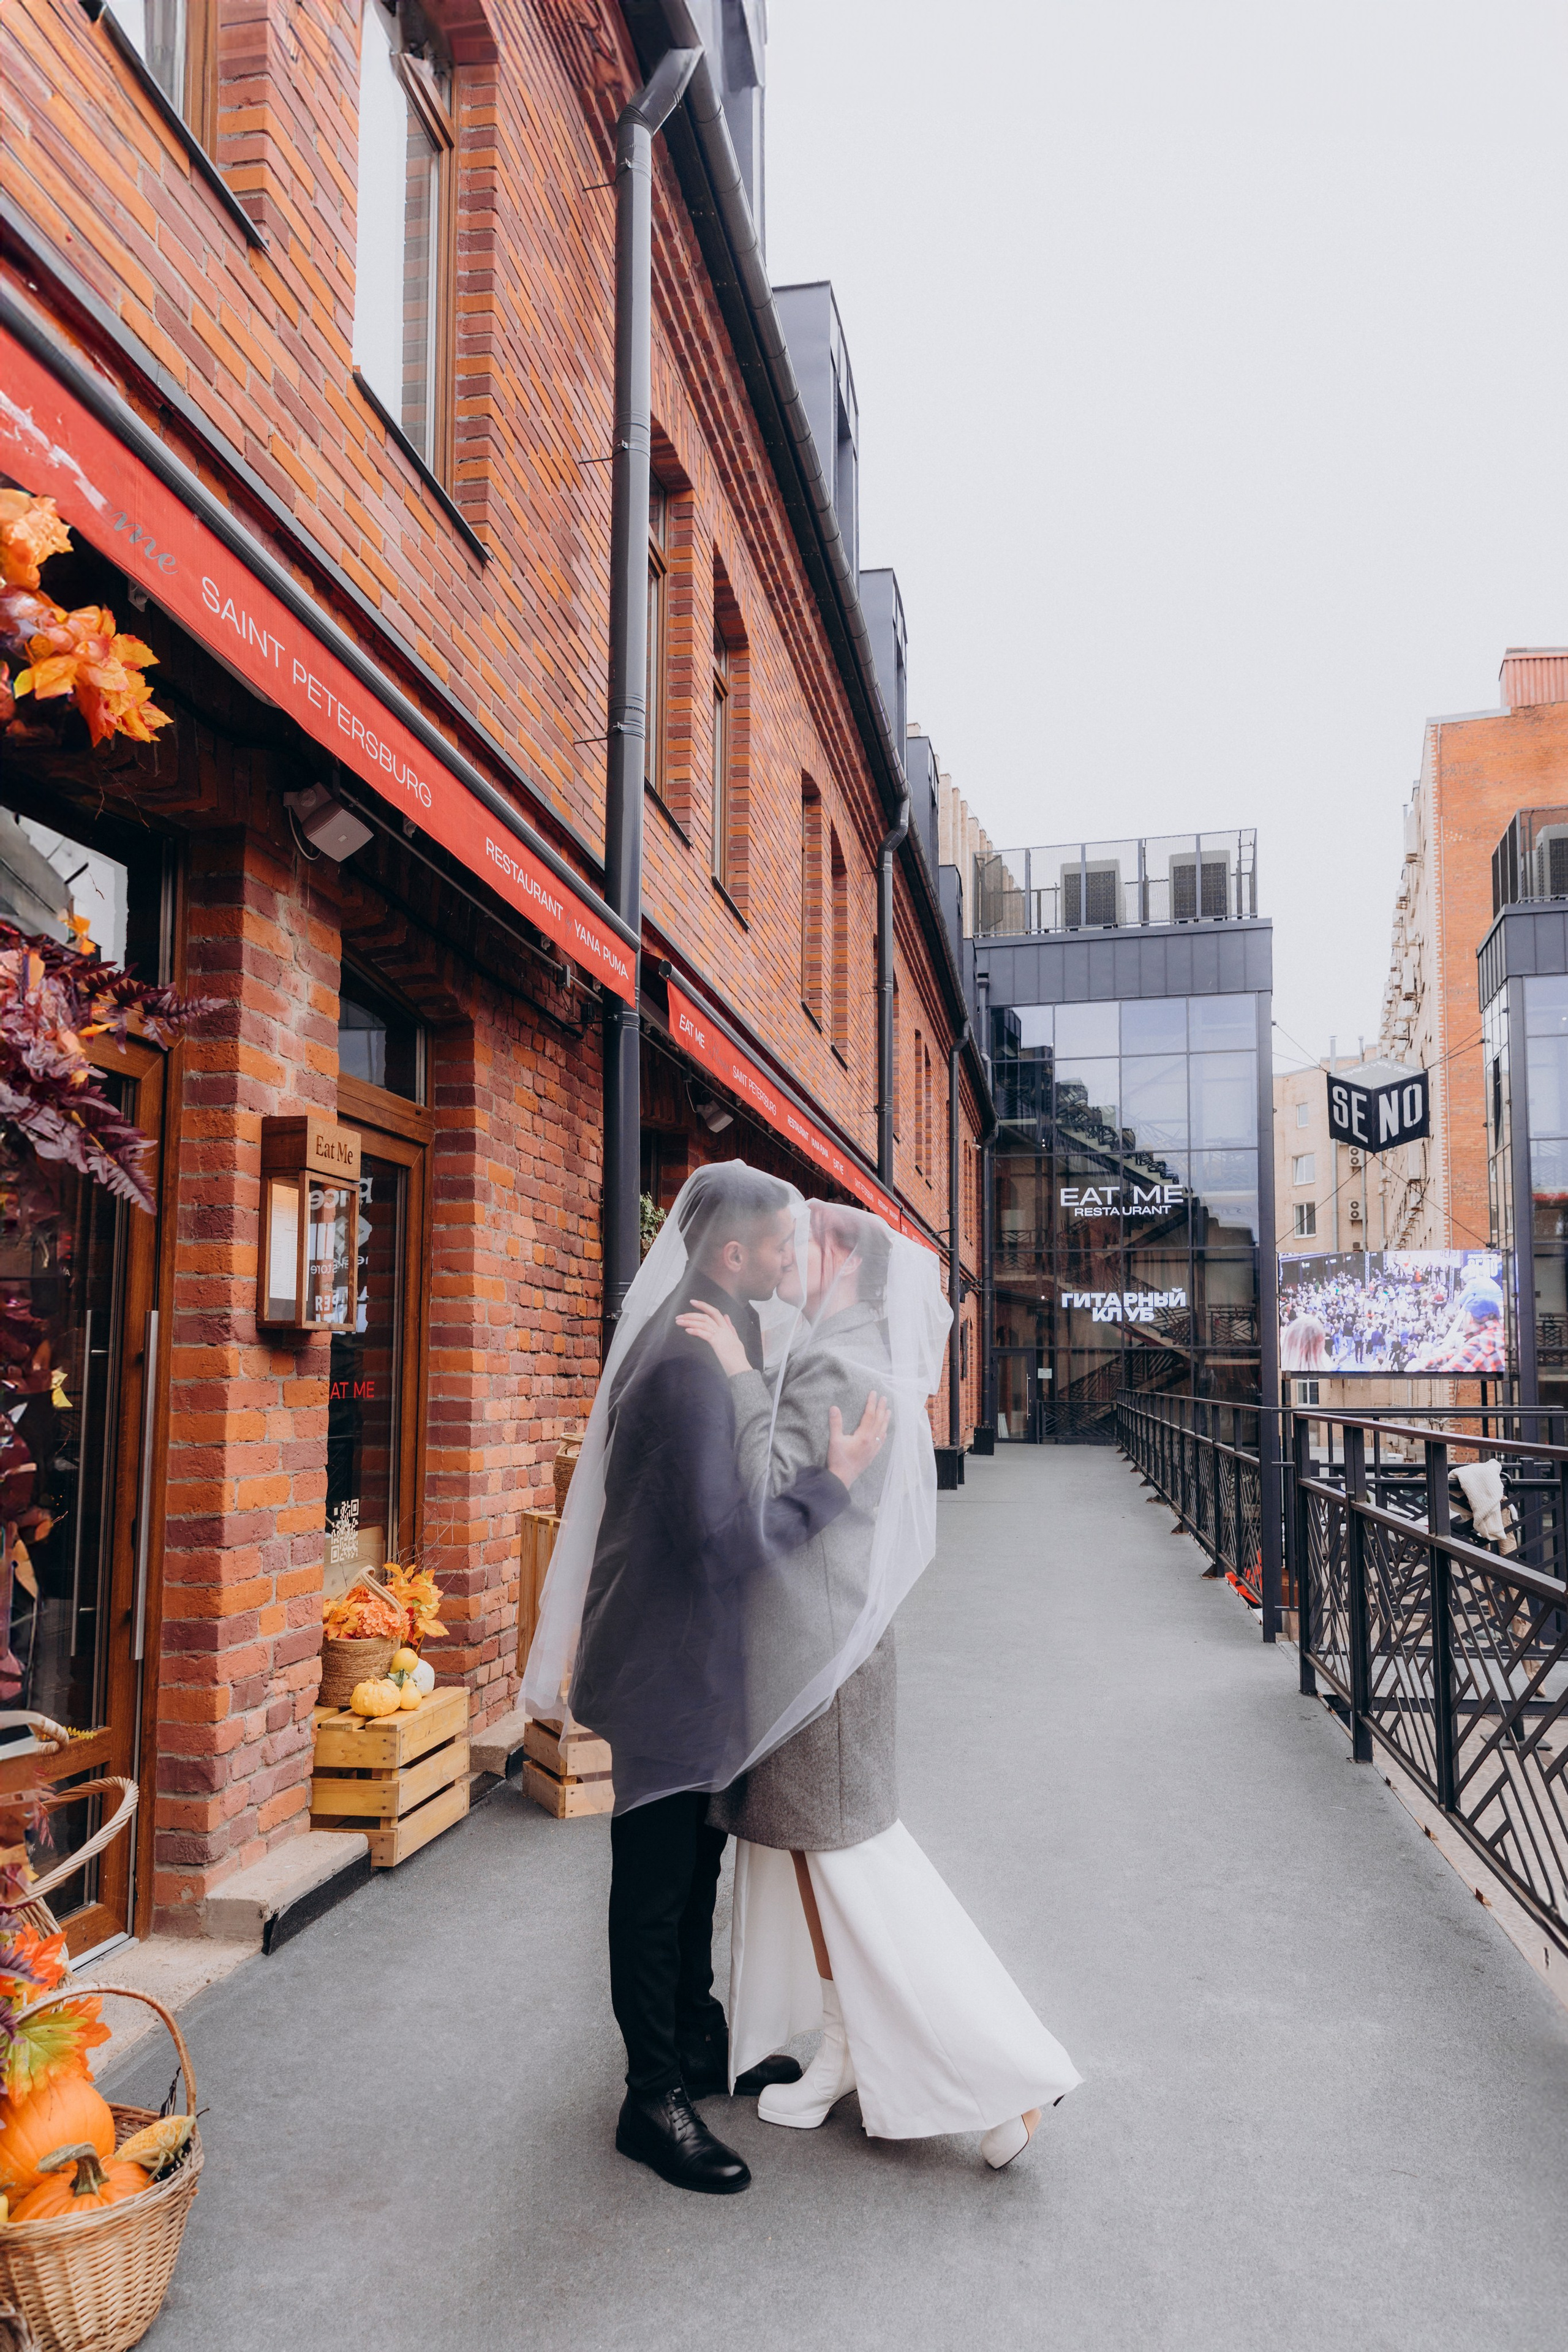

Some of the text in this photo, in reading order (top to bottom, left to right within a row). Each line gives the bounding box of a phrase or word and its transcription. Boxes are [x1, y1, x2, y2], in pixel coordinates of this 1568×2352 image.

[202, 576, 285, 668] SAINT
[293, 658, 432, 808] PETERSBURG
[486, 836, 564, 921] RESTAURANT
[574, 919, 601, 957] YANA
[603, 945, 629, 980] PUMA
[679, 1013, 694, 1038] EAT
[695, 1027, 705, 1049] ME
[733, 1065, 748, 1088] SAINT
[748, 1078, 777, 1117] PETERSBURG
[315, 1134, 353, 1165] Eat Me
[1060, 1184, 1184, 1207] EAT ME
[1074, 1205, 1171, 1217] RESTAURANT
[1061, 1287, 1186, 1308] ГИТАРНЫЙ
[1092, 1307, 1155, 1322] КЛУБ
[353, 1381, 375, 1399] ME
